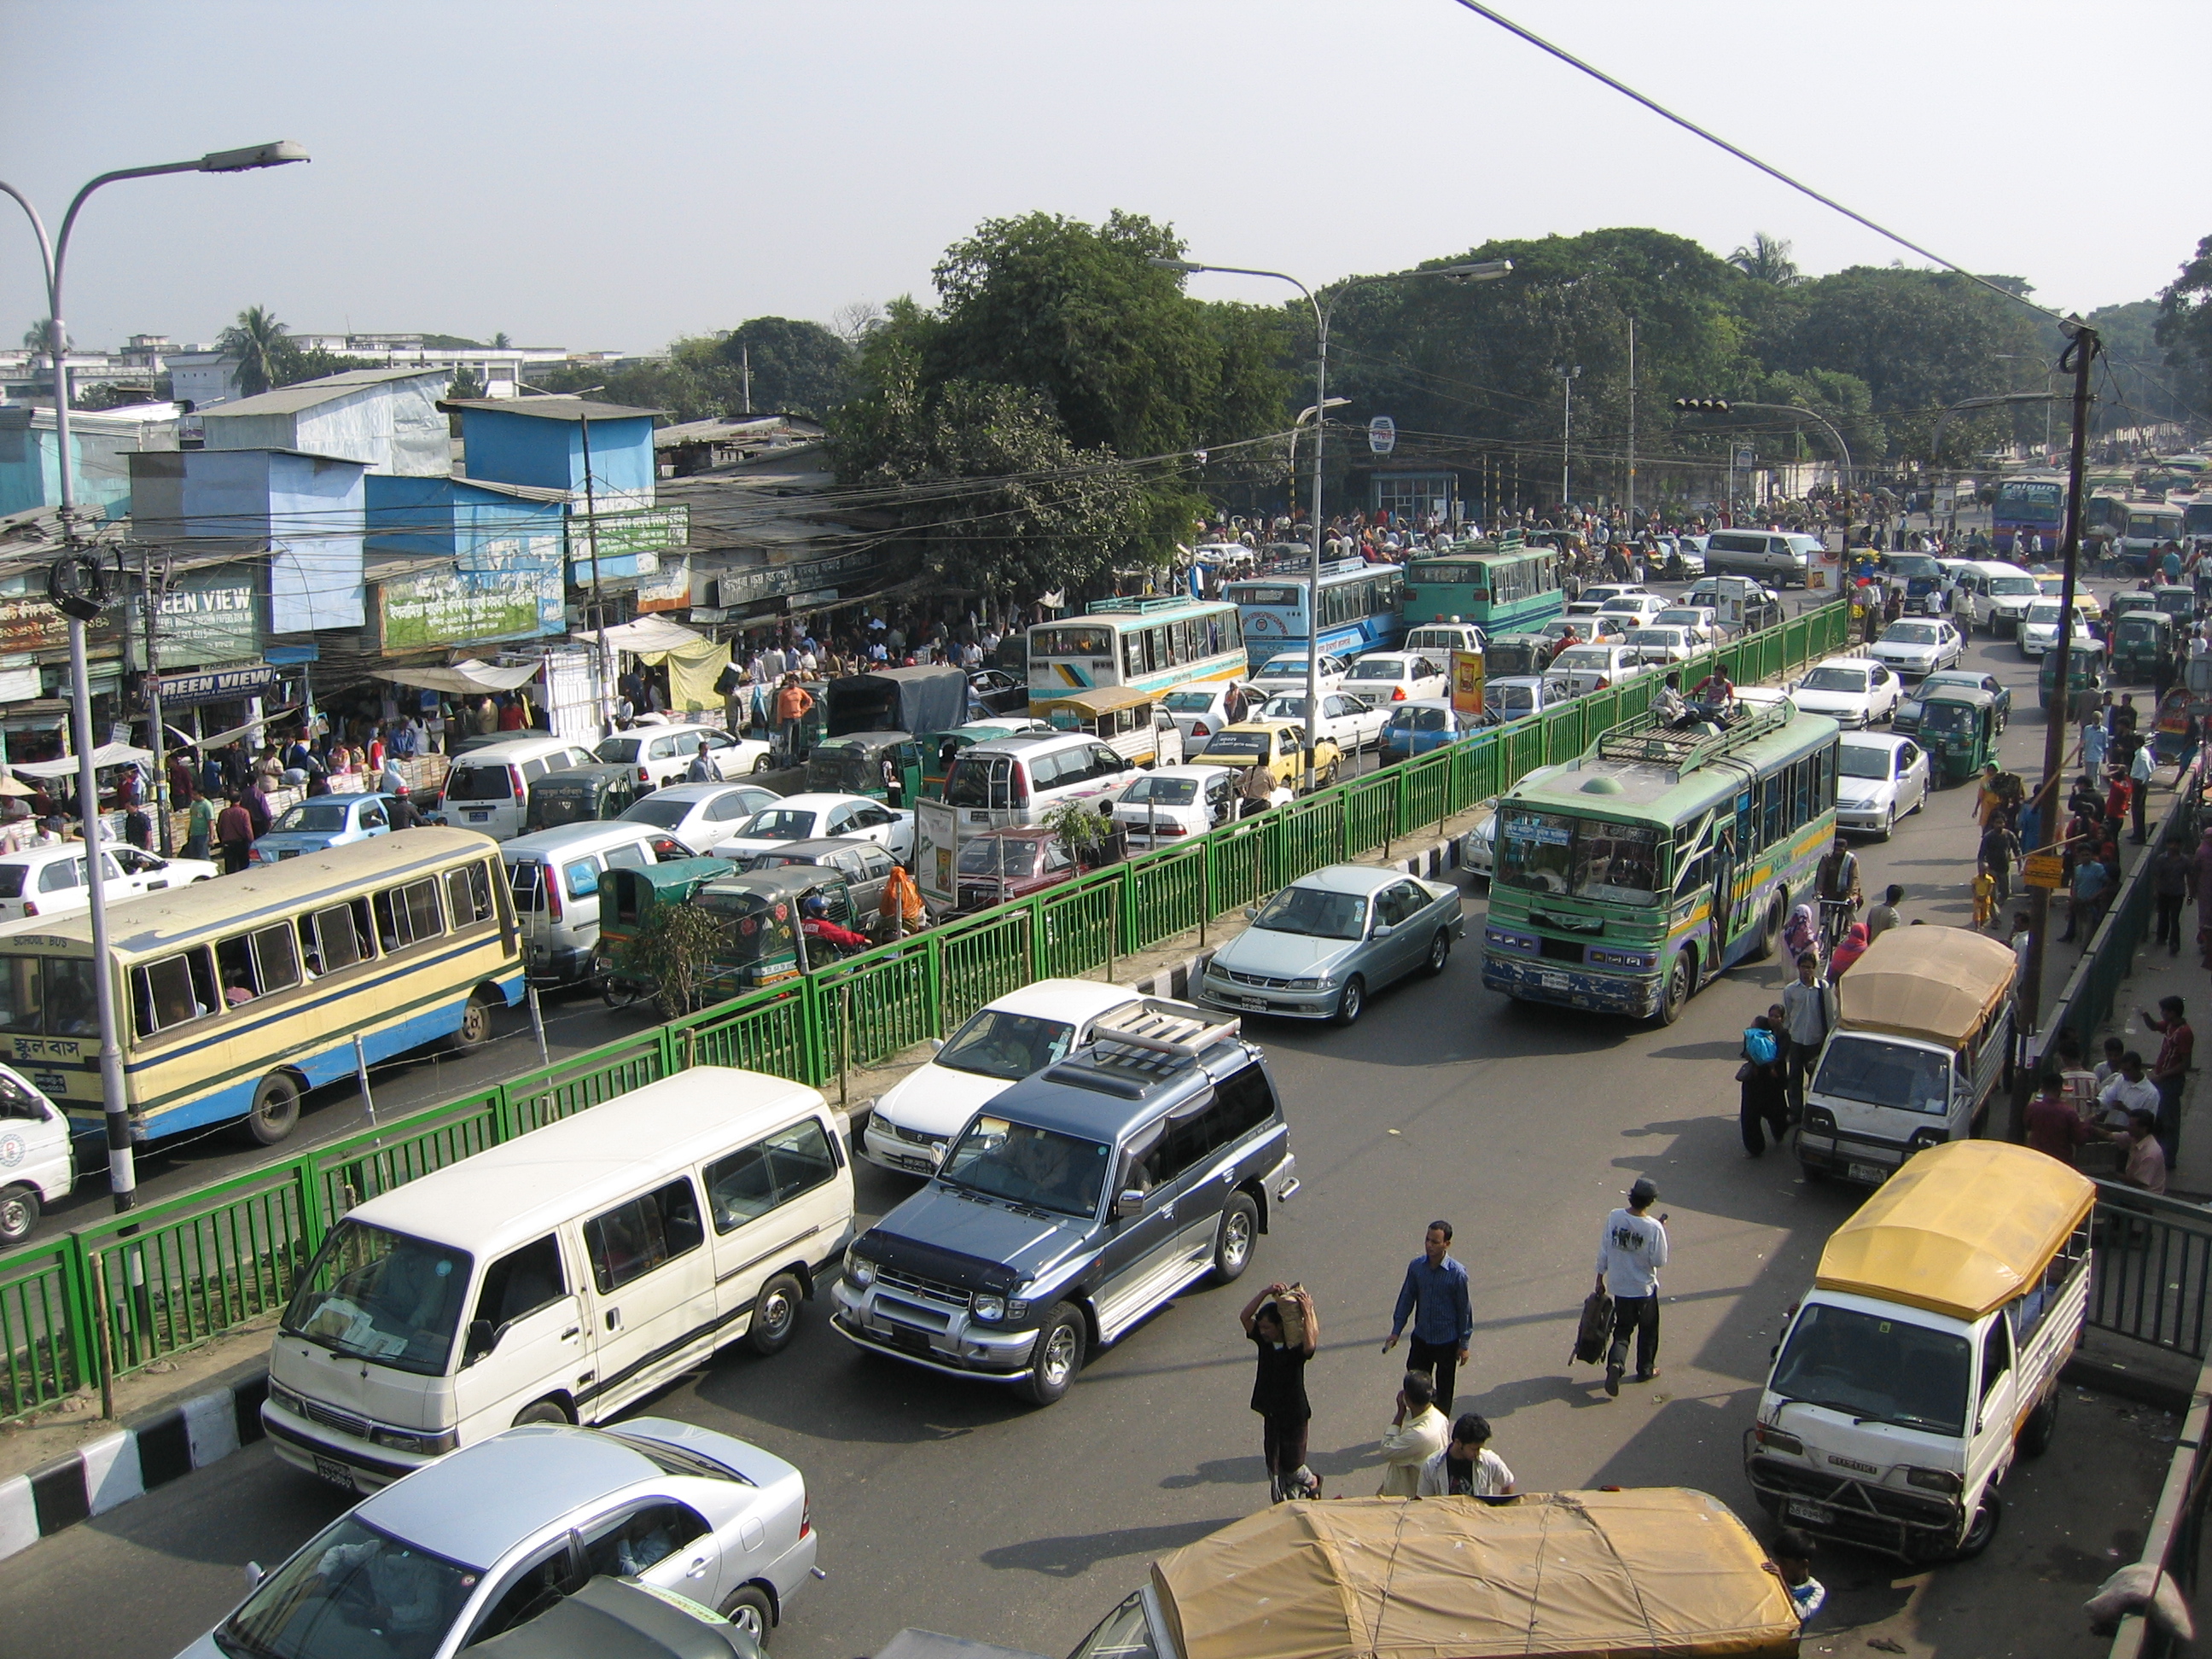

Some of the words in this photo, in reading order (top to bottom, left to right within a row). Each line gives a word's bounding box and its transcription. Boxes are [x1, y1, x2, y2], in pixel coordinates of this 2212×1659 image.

[2002, 483, 2057, 492] Falgun
[202, 586, 252, 611] VIEW
[218, 669, 272, 689] VIEW
[14, 936, 44, 946] SCHOOL
[49, 937, 67, 947] BUS
[15, 1038, 45, 1059] স্কুল
[46, 1040, 80, 1057] বাস
[1830, 1456, 1876, 1474] SUZUKI
